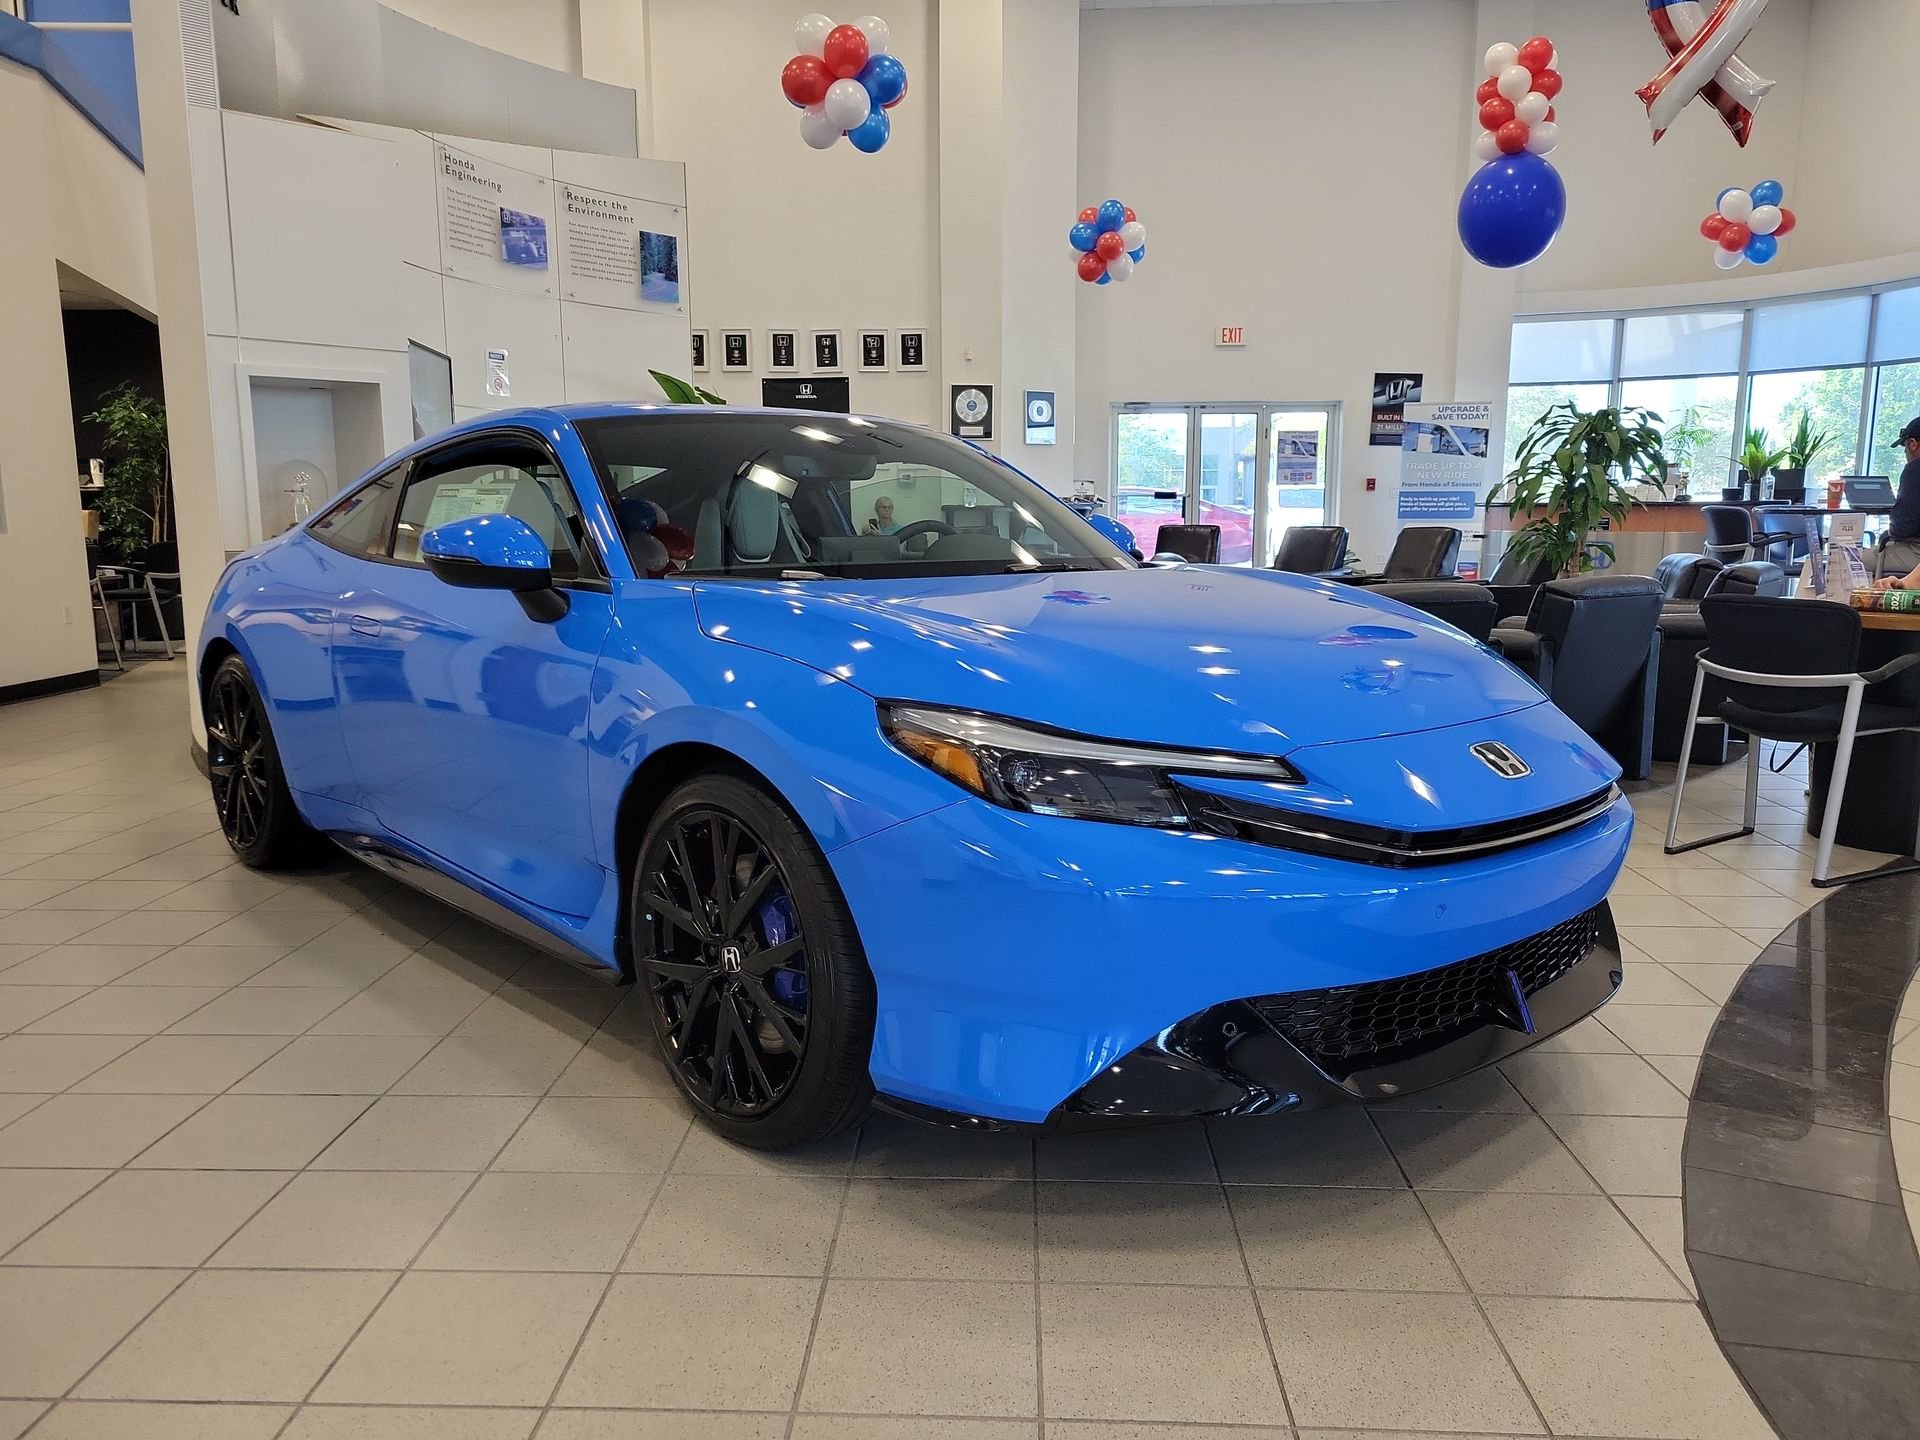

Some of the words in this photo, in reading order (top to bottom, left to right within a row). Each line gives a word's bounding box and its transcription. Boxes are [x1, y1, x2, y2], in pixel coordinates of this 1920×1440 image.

[444, 152, 475, 171] Honda
[446, 164, 502, 193] Engineering
[567, 191, 608, 207] Respect
[612, 201, 628, 211] the
[568, 204, 634, 224] Environment
[1222, 327, 1243, 343] EXIT
[1406, 462, 1439, 470] TRADE
[1890, 591, 1900, 611] 2024
